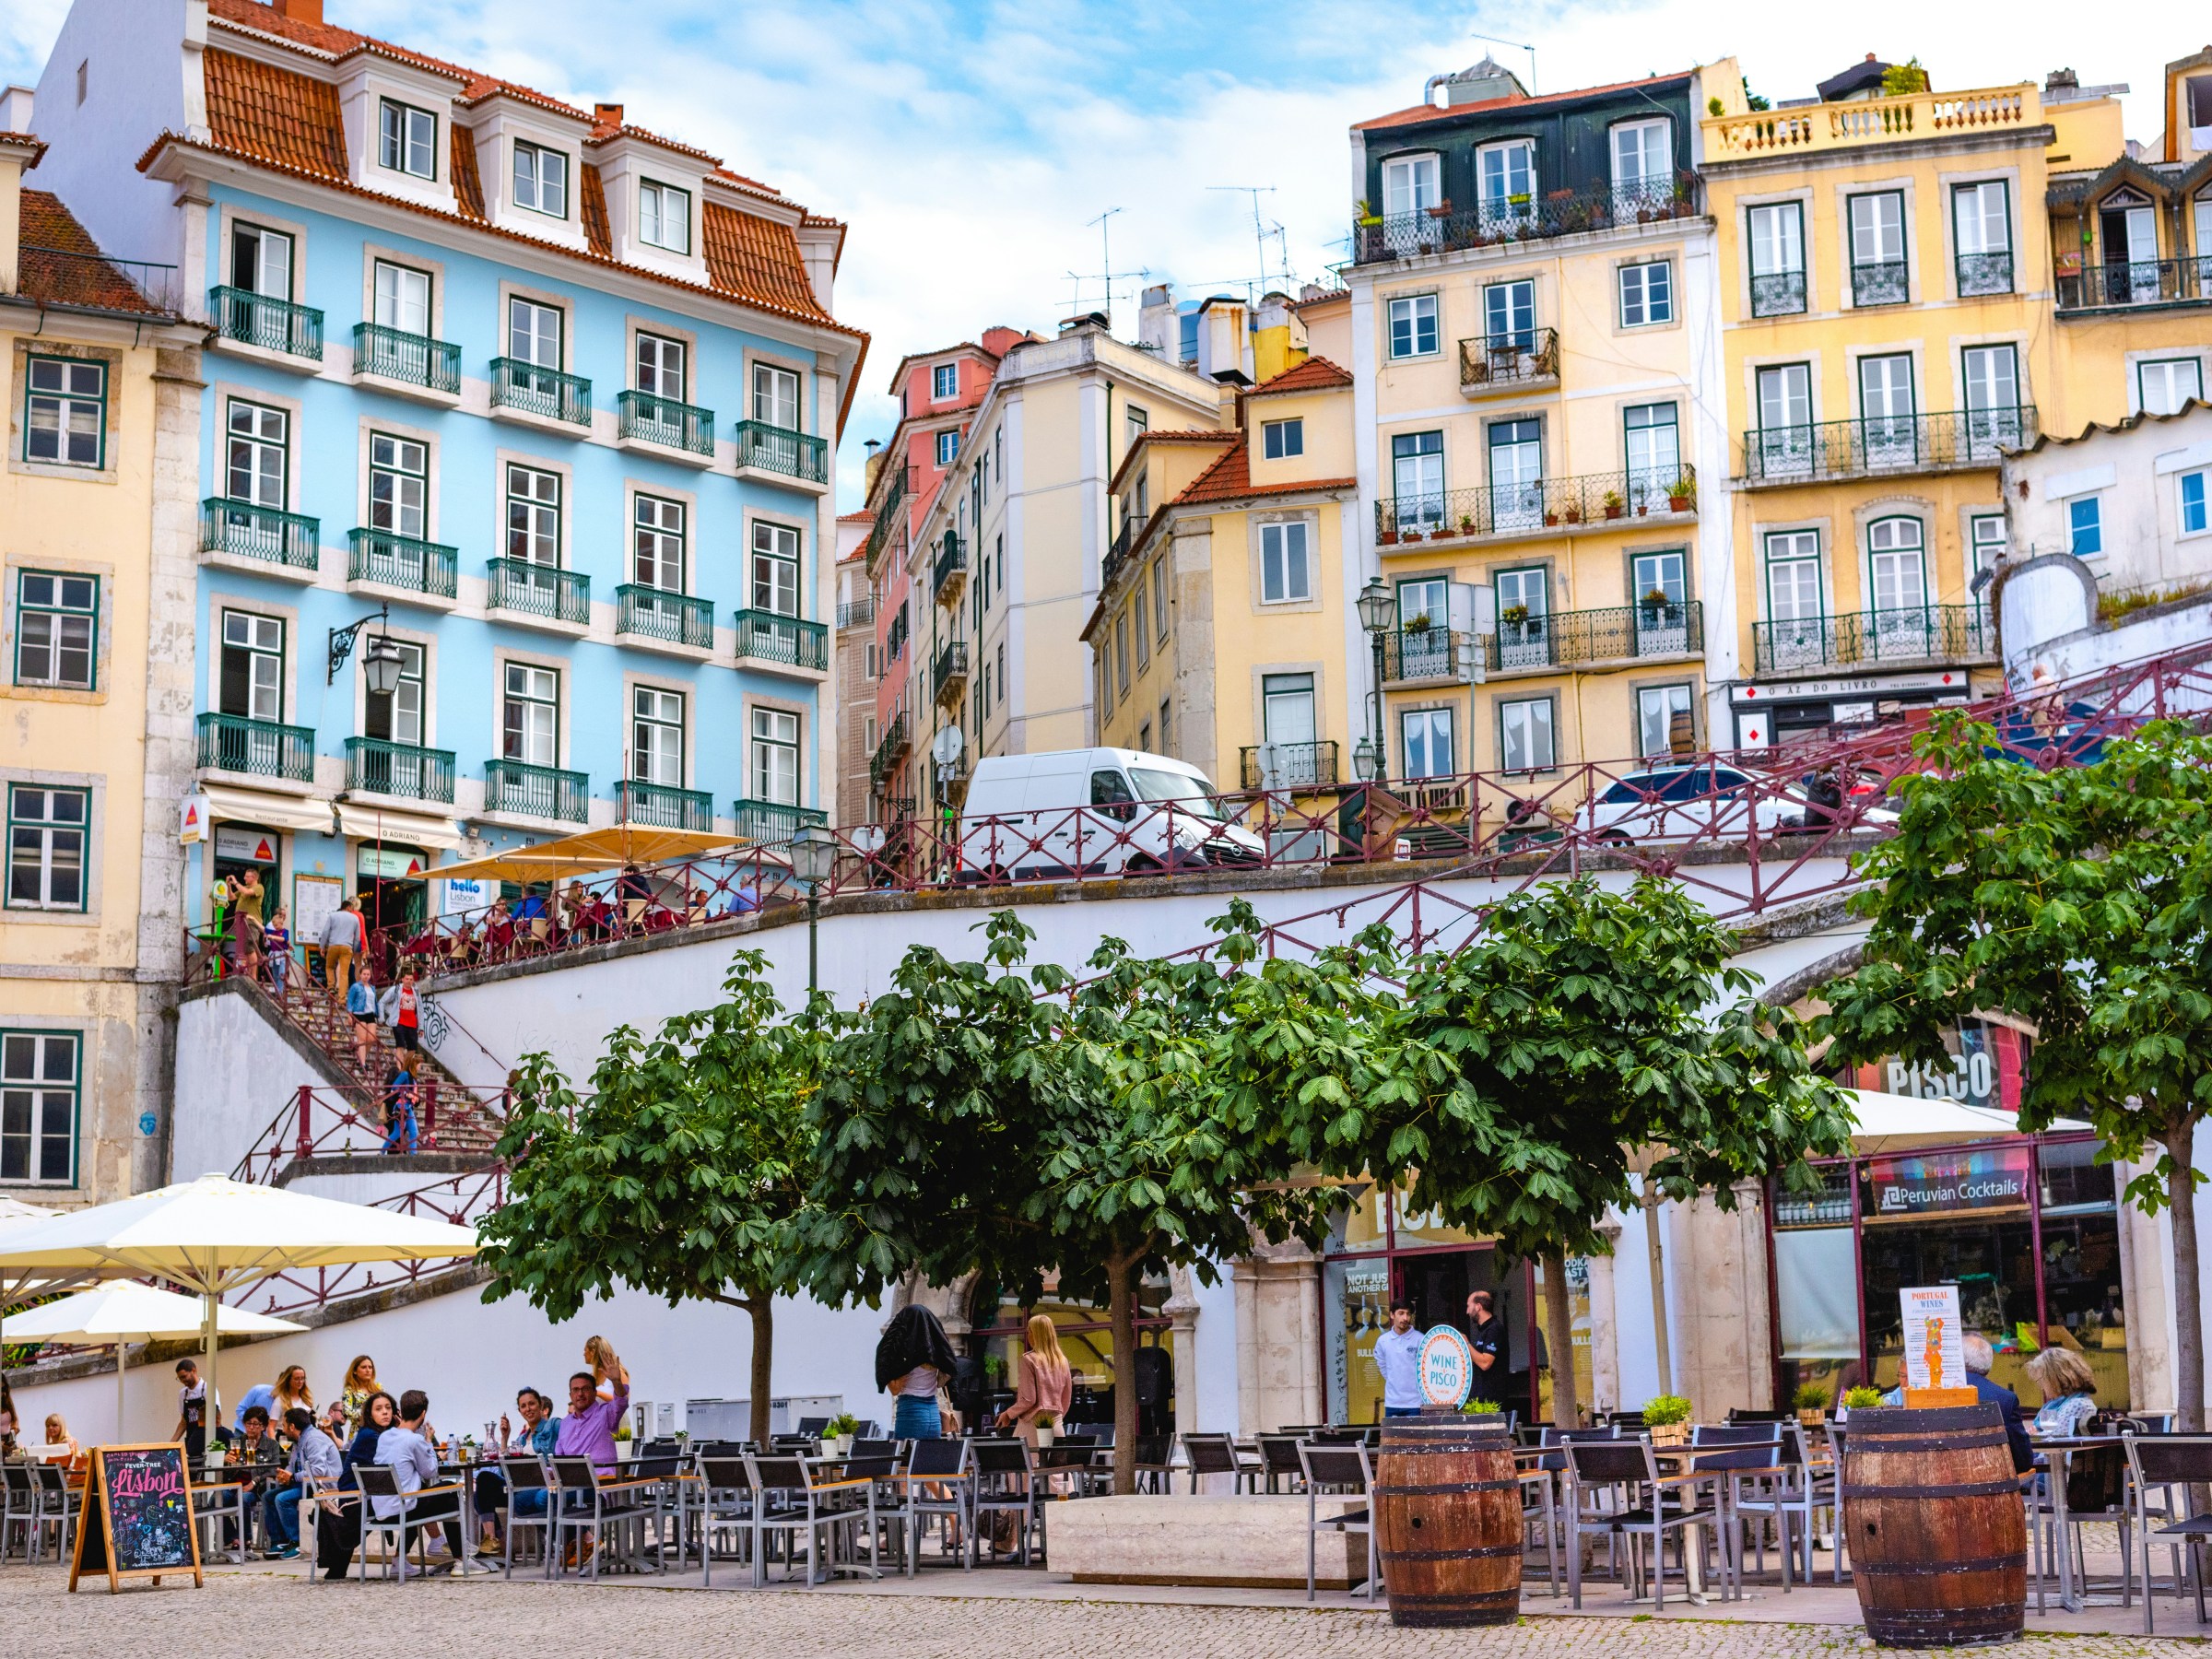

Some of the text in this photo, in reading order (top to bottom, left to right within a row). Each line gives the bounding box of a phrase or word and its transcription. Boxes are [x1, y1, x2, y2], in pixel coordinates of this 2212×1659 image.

[1814, 684, 1828, 692] DO
[1841, 680, 1877, 690] LIVRO
[255, 813, 288, 823] Restaurante
[389, 831, 420, 841] ADRIANO
[223, 839, 249, 847] ADRIANO
[451, 879, 480, 893] hello
[450, 892, 476, 902] Lisbon
[1887, 1053, 1991, 1100] PISCO
[1900, 1179, 2018, 1204] Peruvian Cocktails
[1565, 1257, 1589, 1268] ODKA
[1565, 1267, 1583, 1277] AST
[1347, 1272, 1388, 1286] NOT JUS
[1347, 1284, 1381, 1293] ANOTHER
[1912, 1291, 1948, 1300] PORTUGAL
[1920, 1300, 1943, 1308] WINES
[1430, 1353, 1457, 1370] WINE
[1430, 1371, 1456, 1387] PISCO
[112, 1468, 185, 1499] Lisbon
